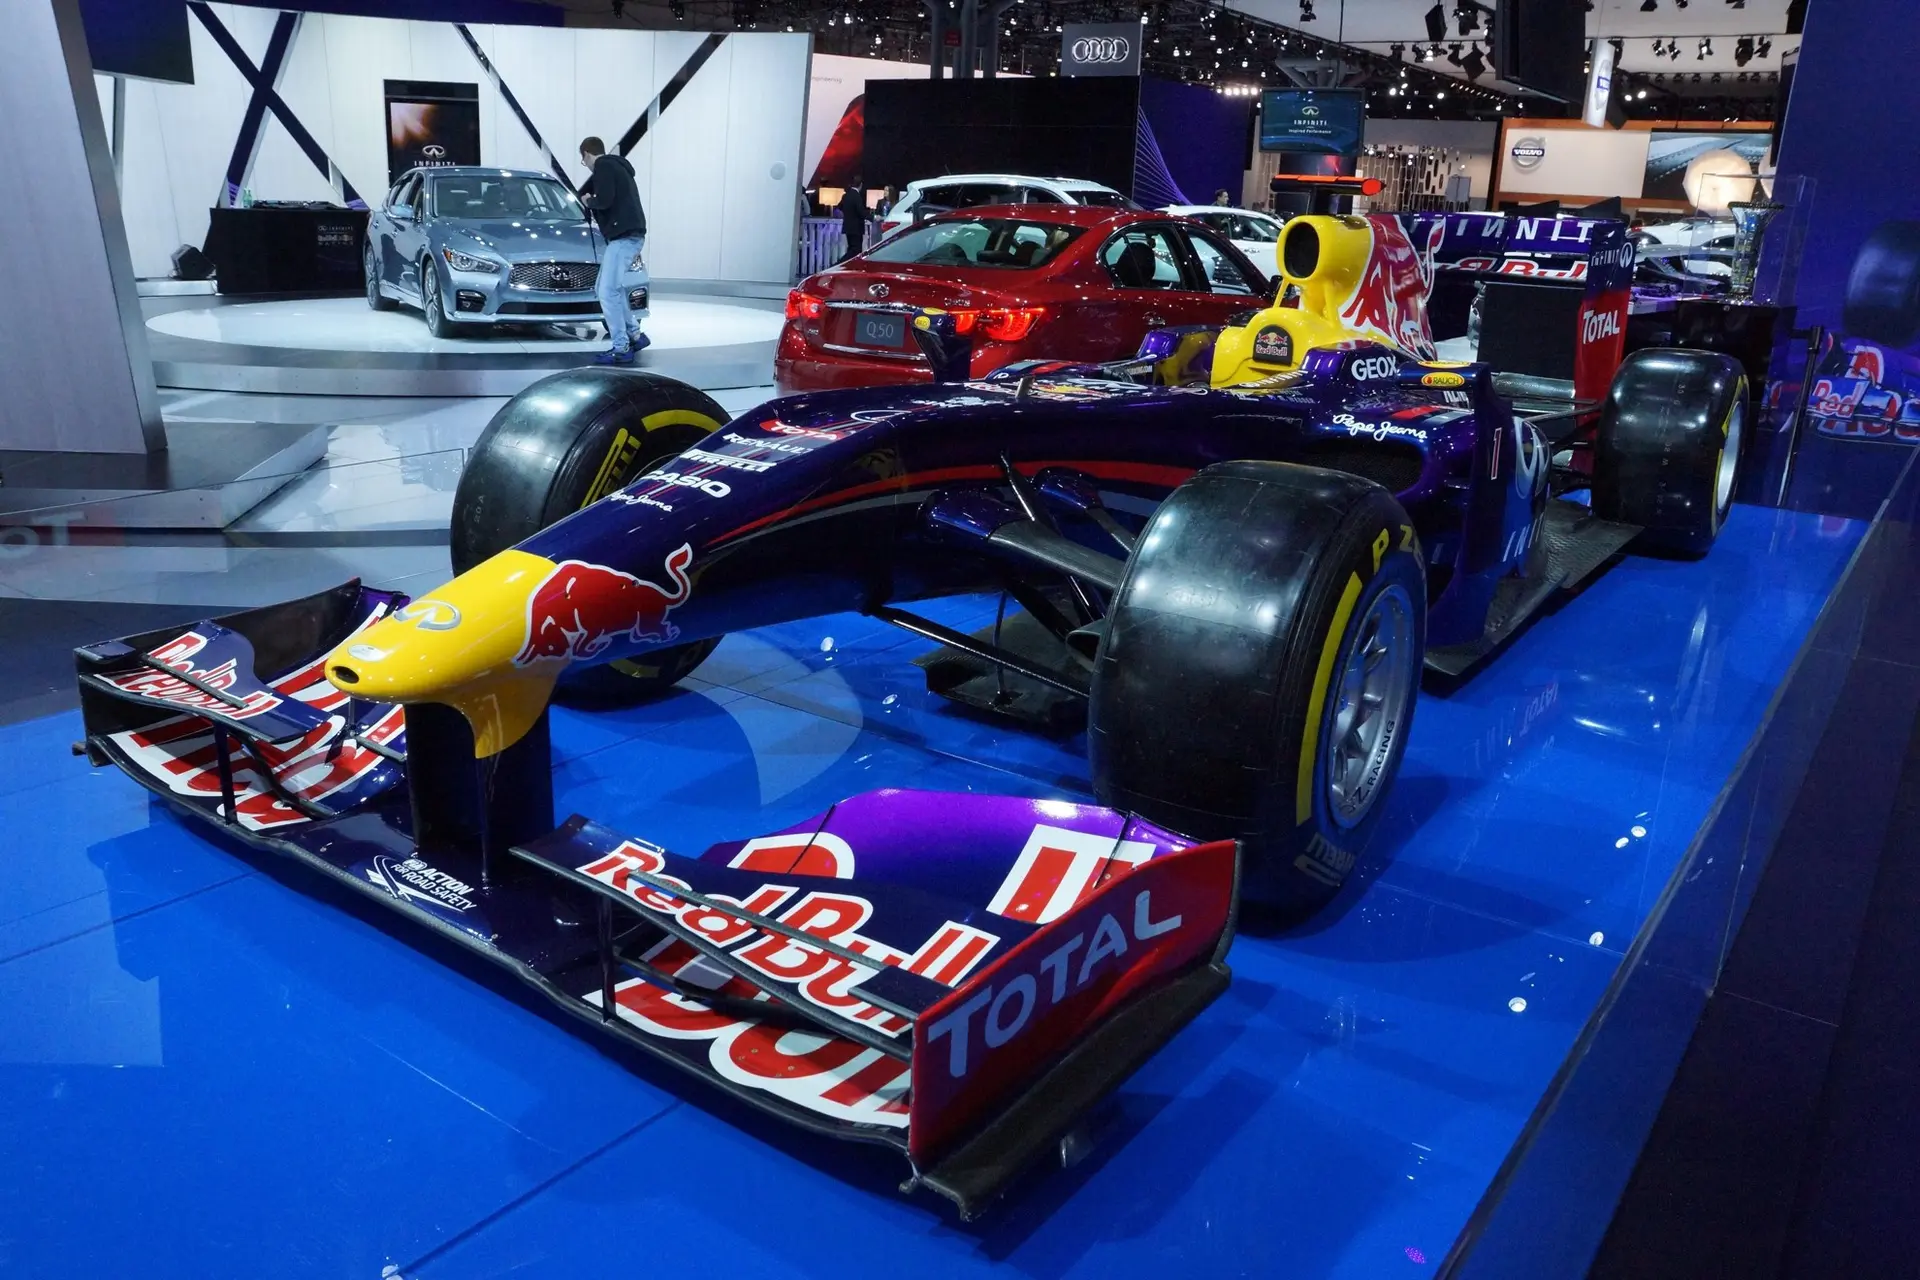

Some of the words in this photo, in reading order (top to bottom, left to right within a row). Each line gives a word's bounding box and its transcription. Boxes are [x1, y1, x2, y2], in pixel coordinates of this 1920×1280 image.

[866, 321, 894, 338] Q50
[1582, 310, 1620, 345] TOTAL
[1256, 343, 1271, 355] Red
[1271, 346, 1288, 356] Bull
[1351, 356, 1398, 381] GEOX
[1433, 376, 1460, 386] RAUCH
[1333, 414, 1376, 436] Pepe
[1374, 421, 1428, 441] Jeans
[722, 432, 815, 455] RENAULT
[679, 448, 778, 473] PIRELLI
[640, 470, 732, 499] CASIO
[1367, 720, 1395, 786] RACING
[390, 863, 410, 875] FOR
[402, 871, 437, 890] ROAD
[430, 886, 477, 910] SAFETY
[418, 867, 475, 896] ACTION
[575, 840, 801, 948] Red
[729, 891, 1001, 1040] Bull
[928, 890, 1182, 1079] TOTAL
